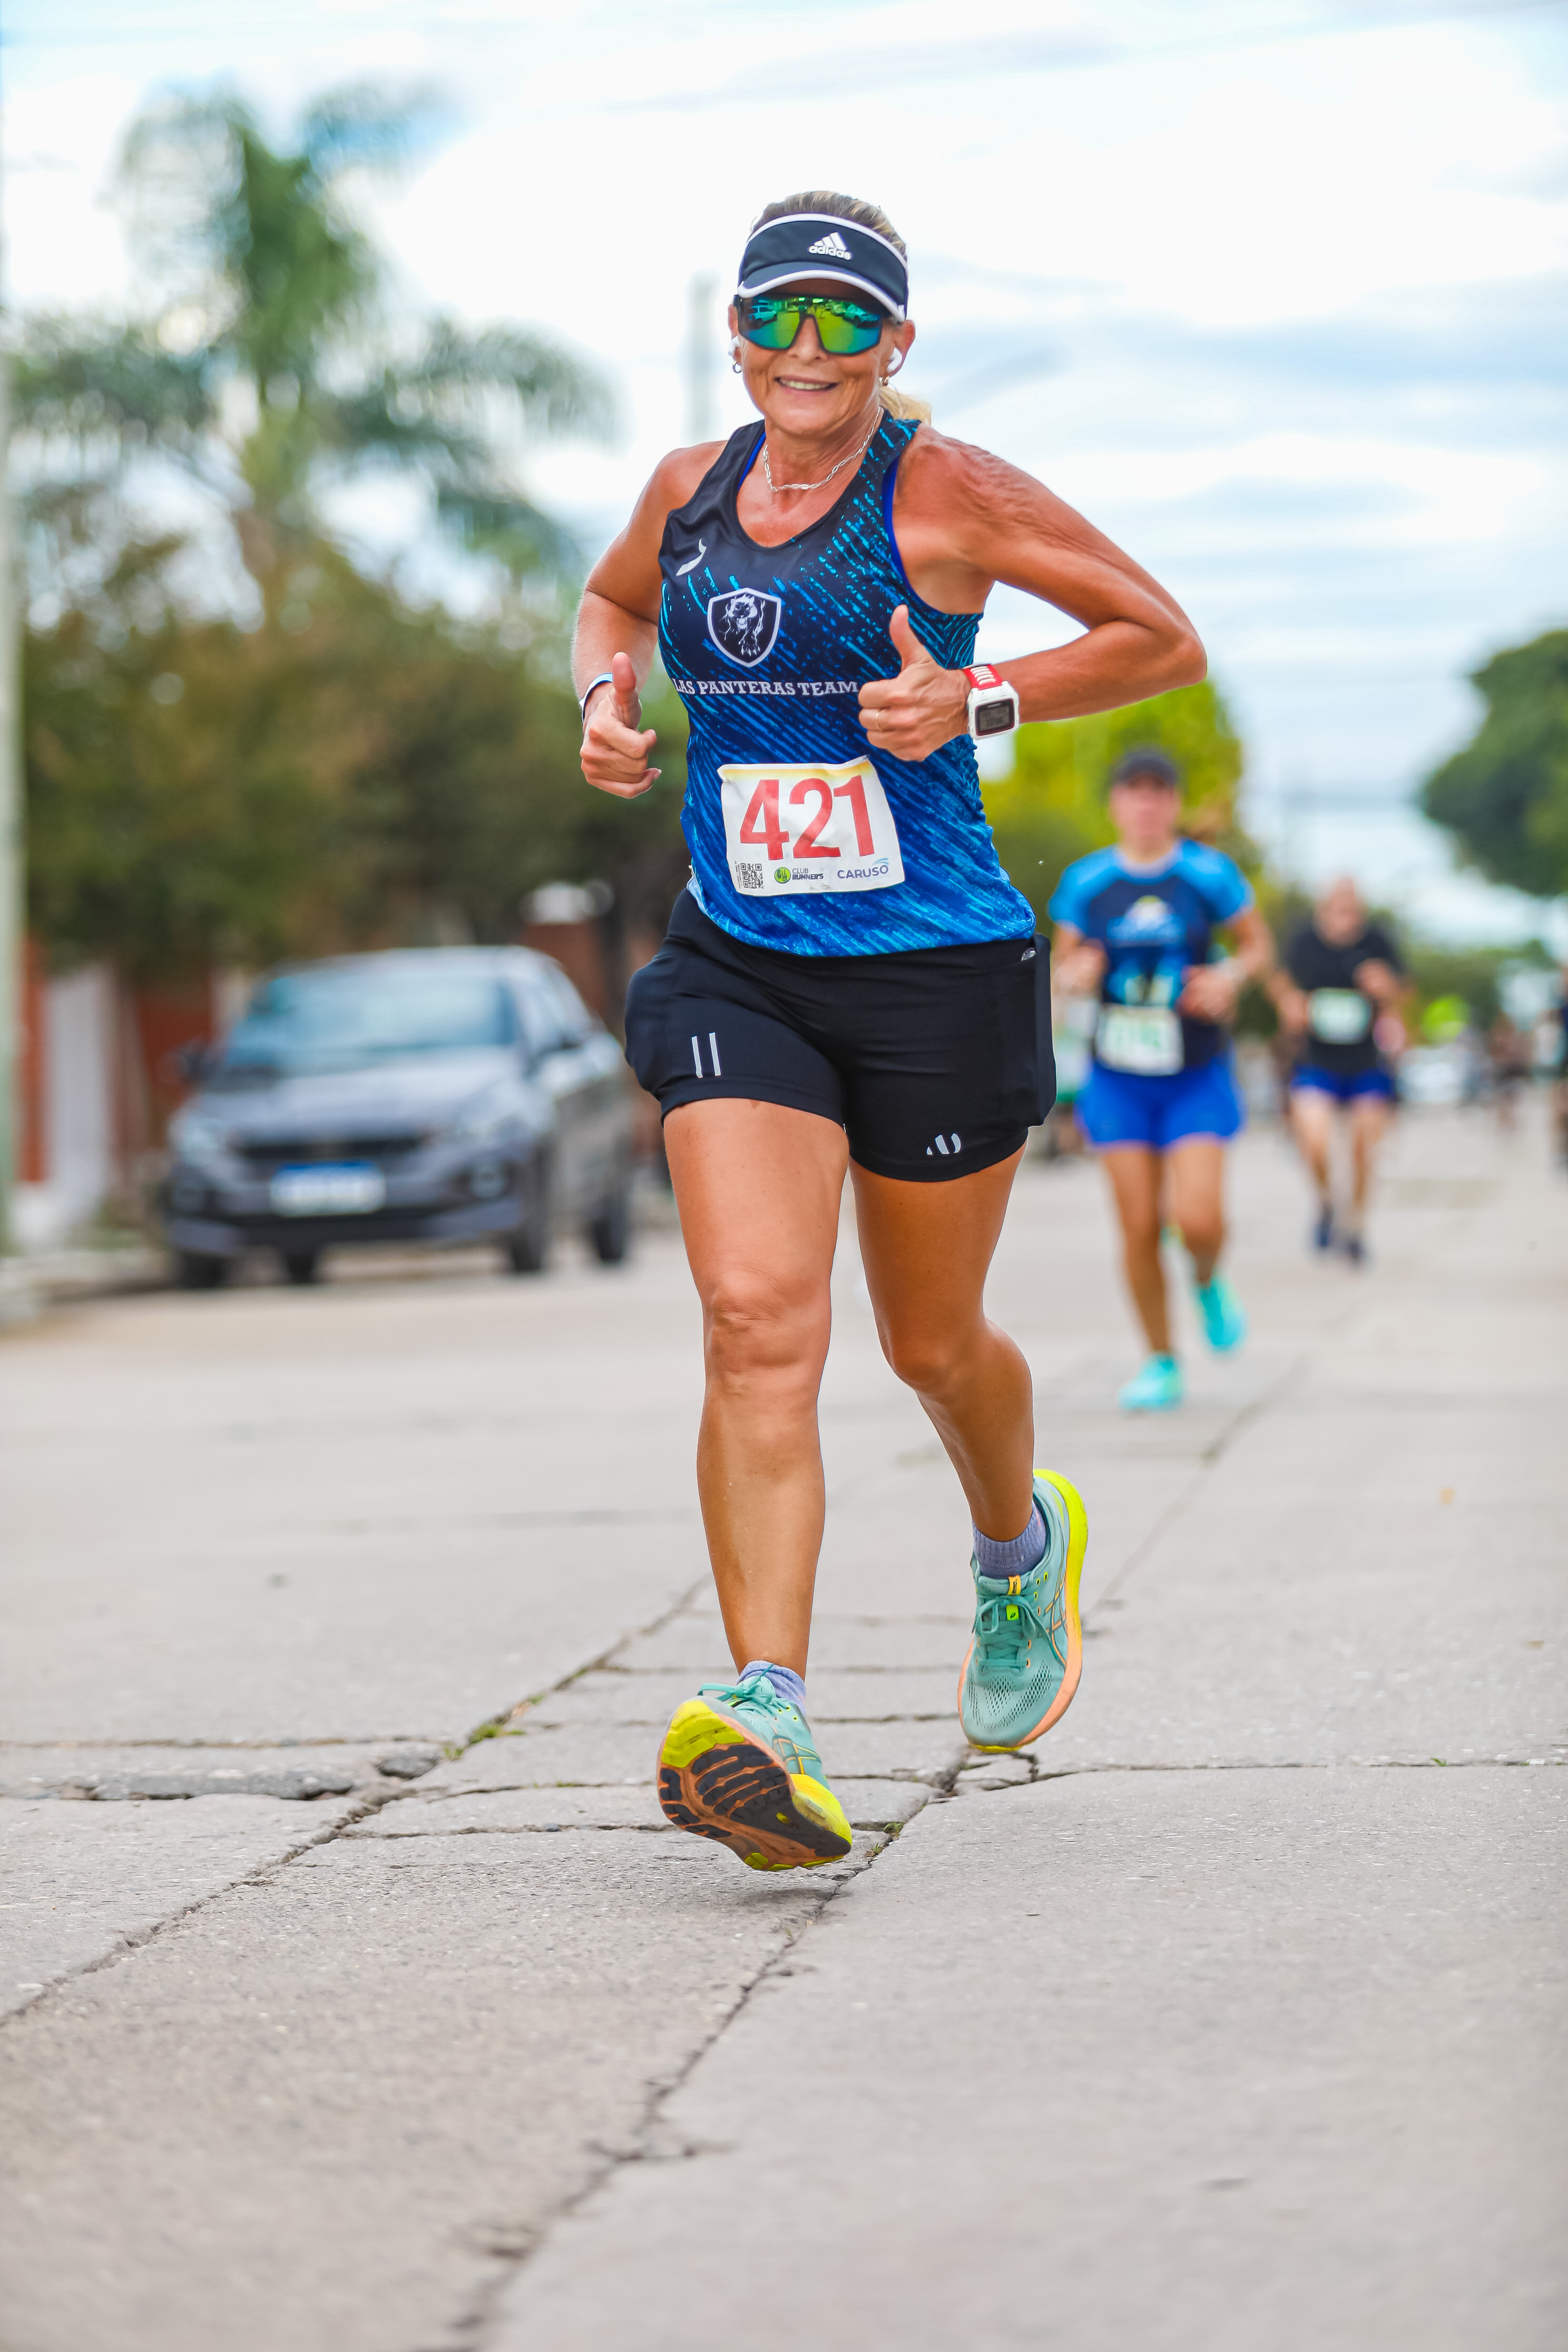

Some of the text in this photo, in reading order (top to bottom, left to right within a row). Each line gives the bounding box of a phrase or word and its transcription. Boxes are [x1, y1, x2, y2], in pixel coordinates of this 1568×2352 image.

[809, 246, 851, 260] adidas
[672, 678, 858, 695] LAS PANTERAS TEAM
[740, 775, 875, 860] 421
[837, 865, 888, 879] CARUSO
